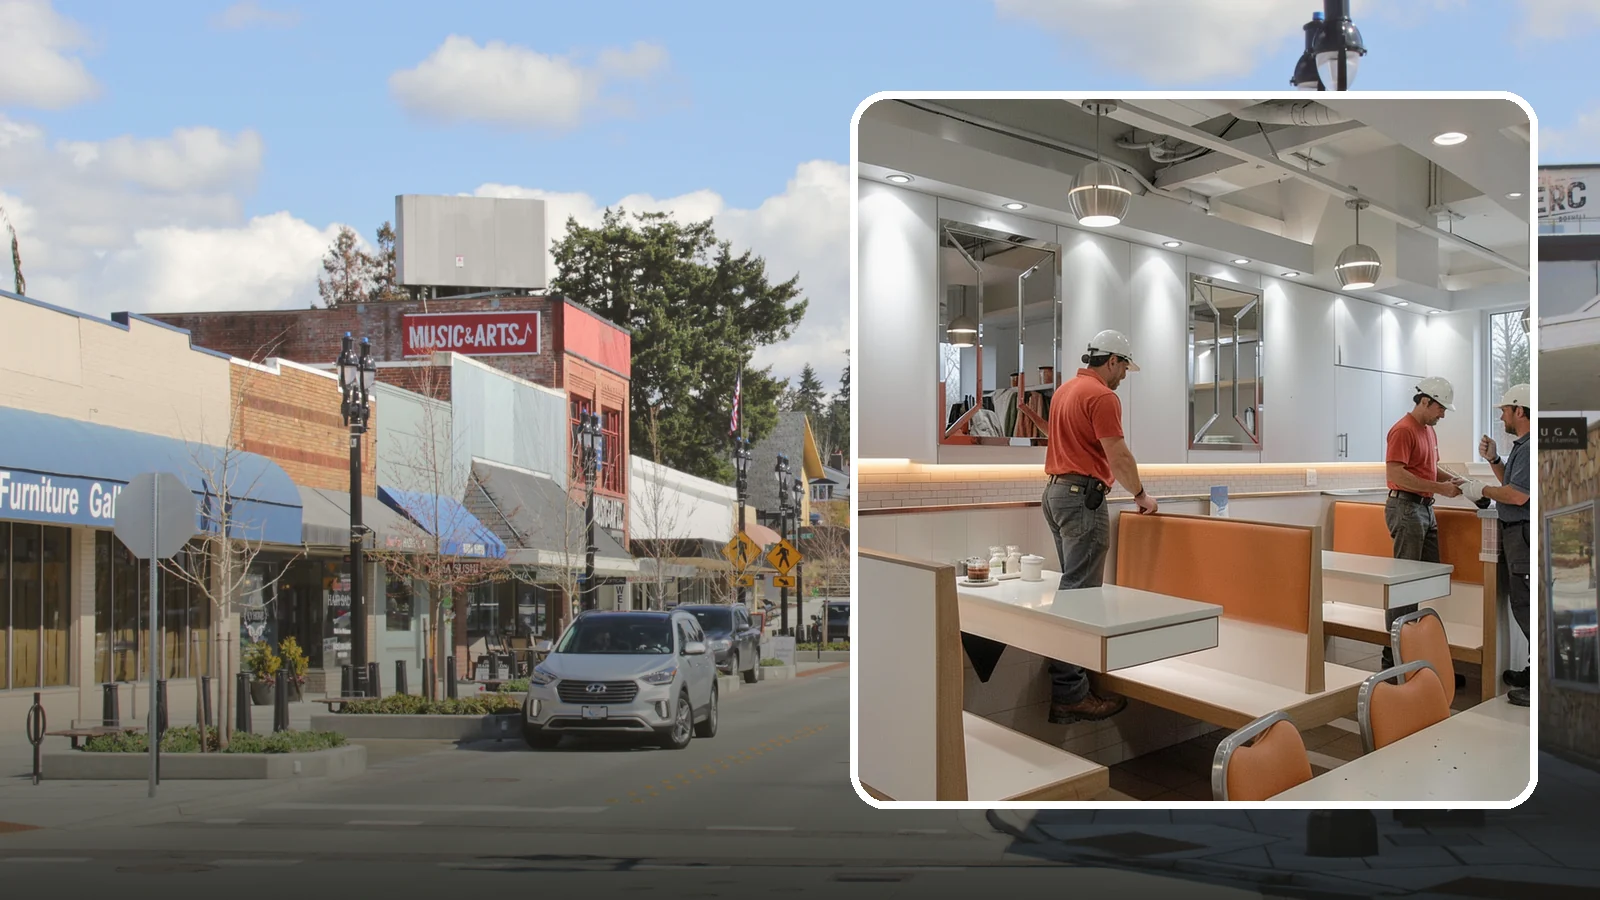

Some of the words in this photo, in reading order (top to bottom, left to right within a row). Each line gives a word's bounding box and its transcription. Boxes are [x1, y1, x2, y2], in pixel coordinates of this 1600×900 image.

[1538, 181, 1587, 213] ERC
[1540, 427, 1577, 436] UGA
[0, 471, 79, 516] Furniture
[89, 482, 122, 519] Gal
[453, 563, 479, 574] SUSHI
